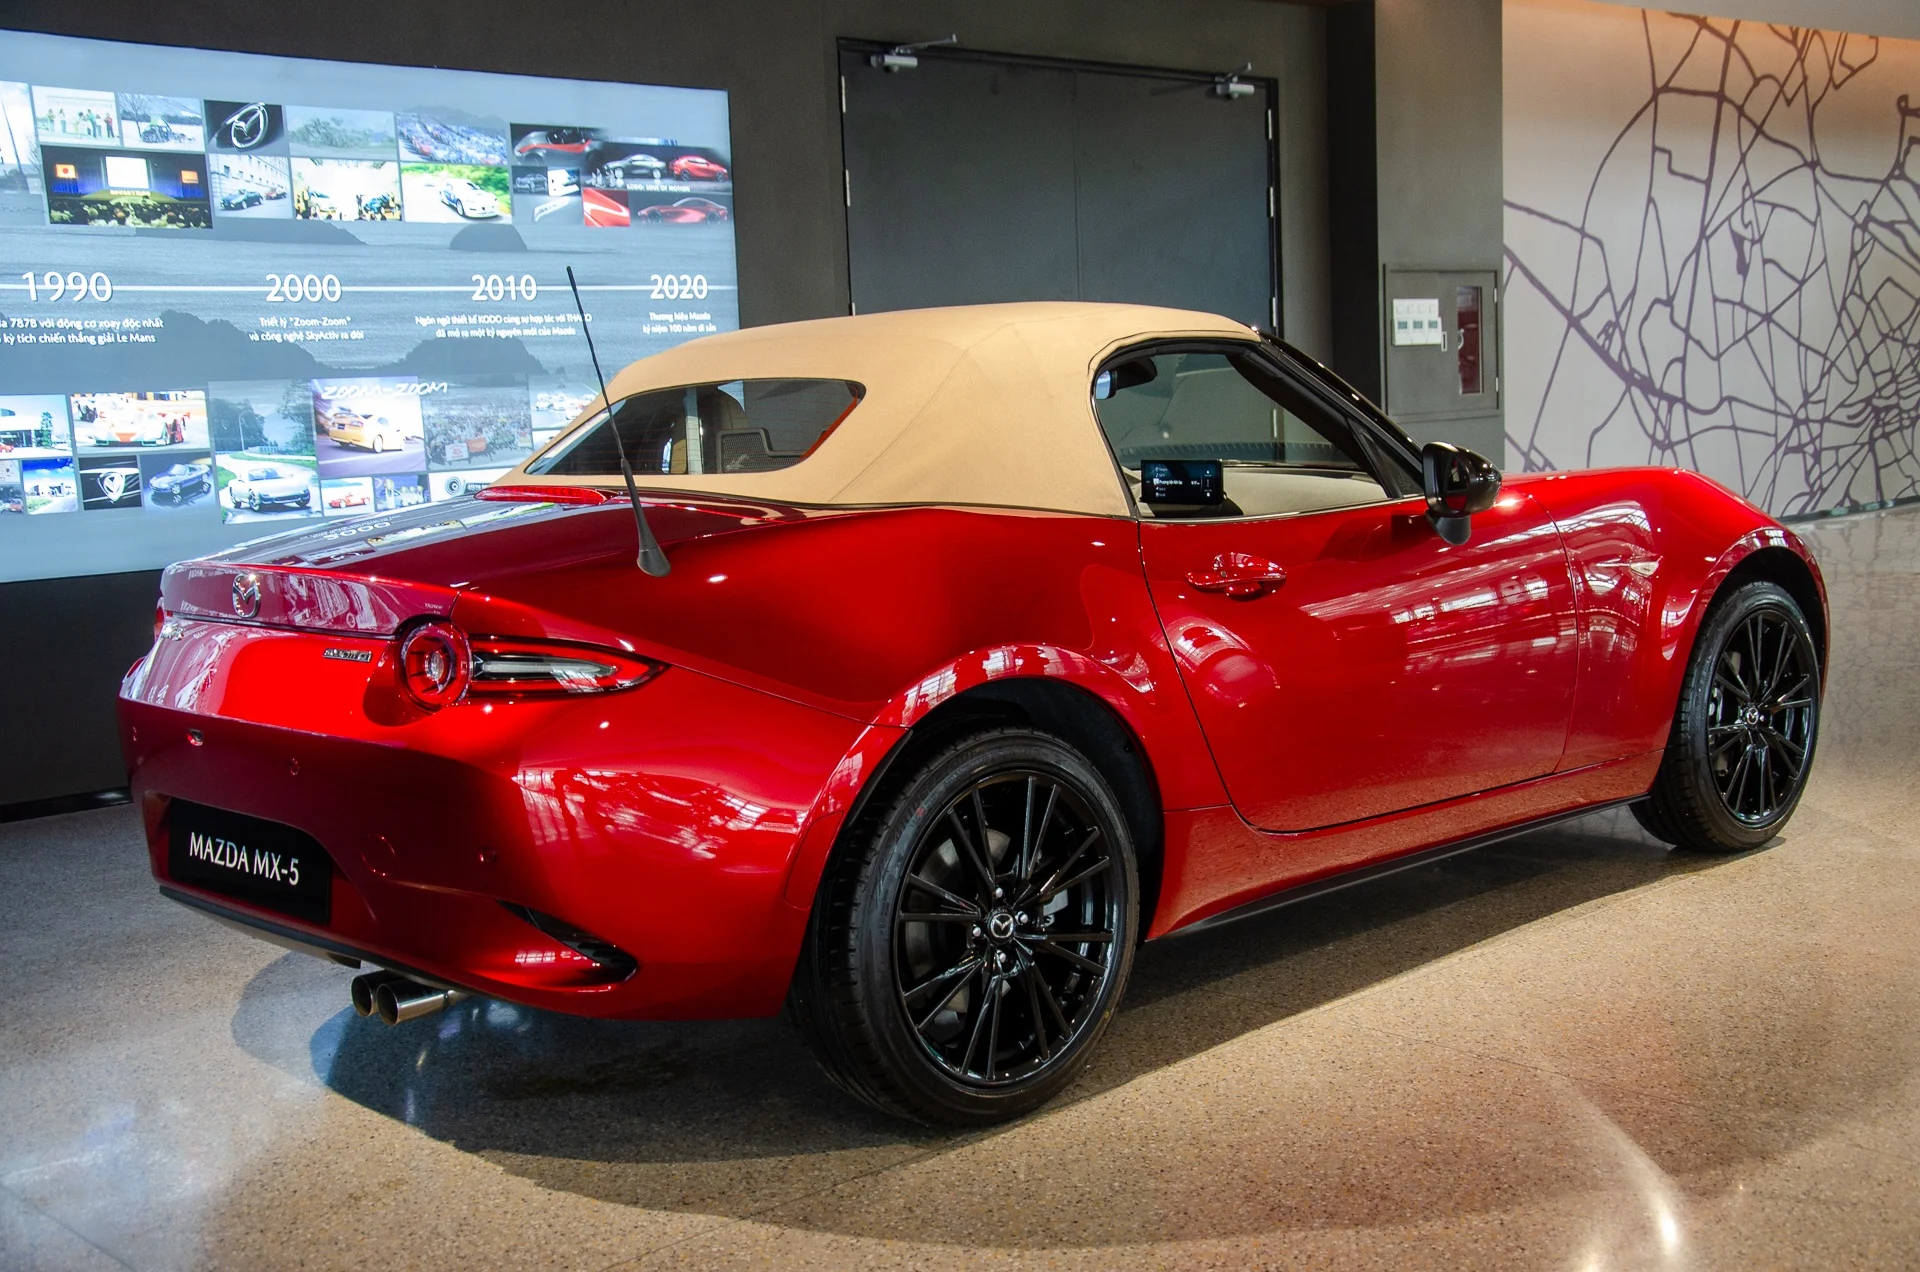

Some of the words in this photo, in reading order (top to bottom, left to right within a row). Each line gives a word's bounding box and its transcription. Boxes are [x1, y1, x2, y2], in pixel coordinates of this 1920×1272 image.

[22, 271, 113, 302] 1990
[265, 273, 342, 303] 2000
[471, 274, 538, 302] 2010
[650, 274, 708, 300] 2020
[10, 317, 38, 329] 787B
[39, 317, 55, 328] với
[57, 317, 84, 330] động
[99, 319, 121, 330] xoay
[122, 317, 141, 329] độc
[142, 316, 164, 328] nhất
[478, 314, 502, 324] KODO
[566, 313, 593, 323] THAO
[17, 332, 37, 344] tích
[39, 331, 66, 344] chiến
[130, 332, 156, 343] Mans
[320, 381, 448, 400] ZOOM-ZOOM
[189, 831, 250, 873] MAZDA
[253, 848, 300, 886] MX-5
